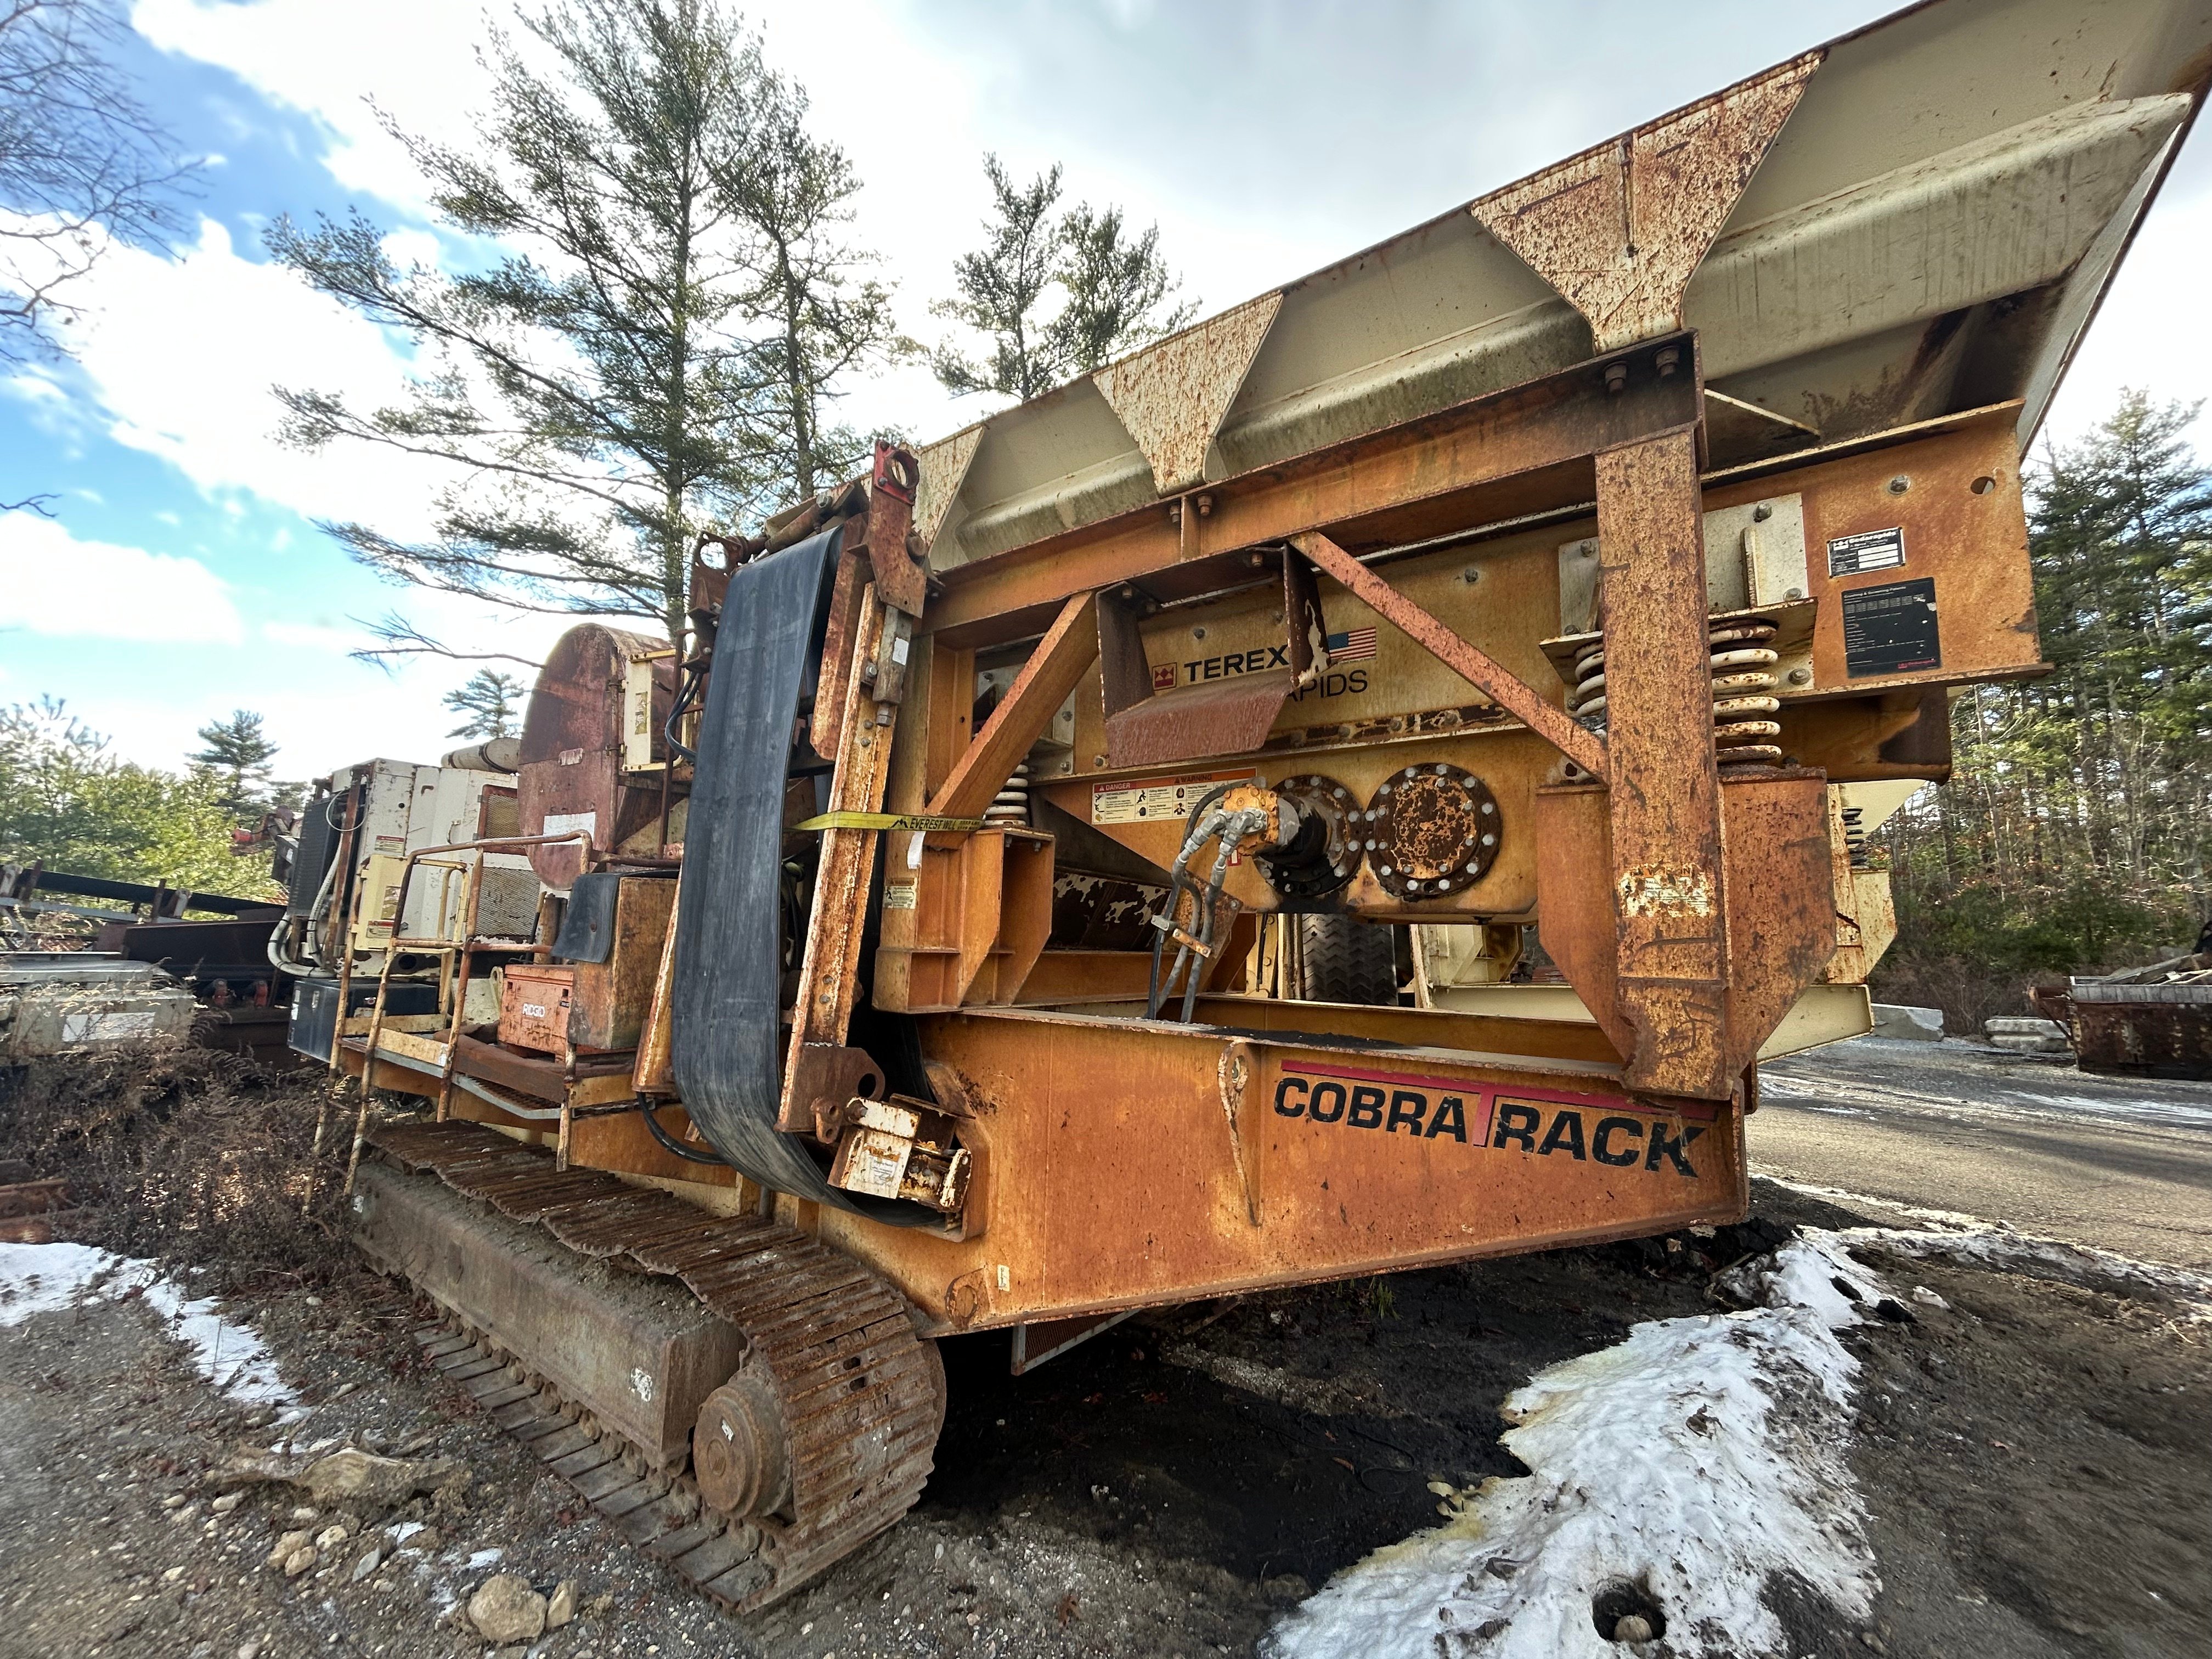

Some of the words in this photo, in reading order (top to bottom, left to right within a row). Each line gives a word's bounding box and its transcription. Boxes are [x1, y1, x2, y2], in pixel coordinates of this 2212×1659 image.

[1184, 644, 1289, 682] TEREX
[1181, 774, 1212, 782] WARNING
[1105, 783, 1131, 791] DANGER
[910, 817, 943, 830] EVEREST
[522, 1003, 545, 1018] RIDGID
